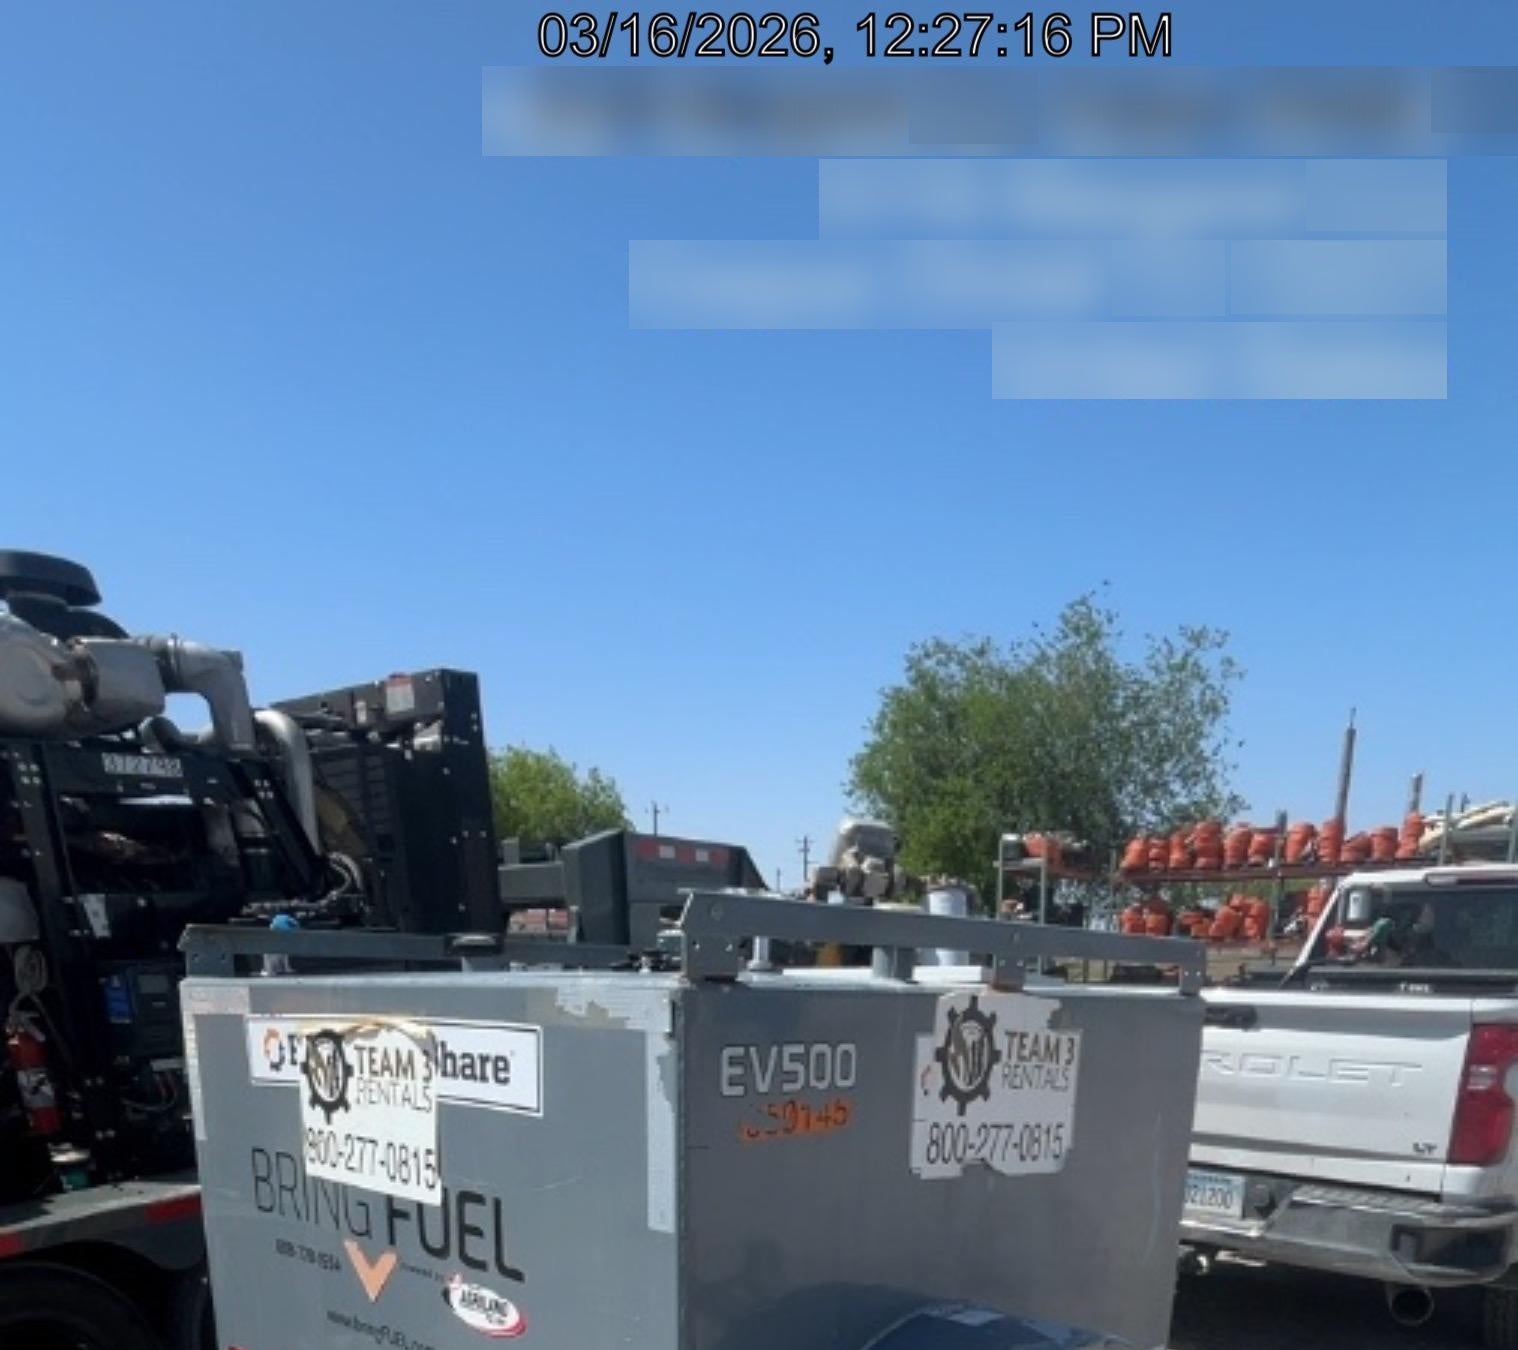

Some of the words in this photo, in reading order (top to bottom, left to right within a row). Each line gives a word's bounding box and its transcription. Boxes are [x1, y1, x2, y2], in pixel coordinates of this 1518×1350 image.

[354, 1044, 415, 1081] TEAM
[421, 1049, 433, 1084] 3
[1004, 1029, 1061, 1065] TEAM
[1064, 1036, 1076, 1067] 3
[720, 1043, 857, 1097] EV500
[1002, 1063, 1069, 1093] RENTALS
[355, 1077, 433, 1114] RENTALS
[306, 1126, 437, 1190] 800-277-0815
[926, 1120, 1066, 1165] 800-277-0815
[251, 1147, 373, 1239] BRING
[386, 1187, 526, 1283] FUEL
